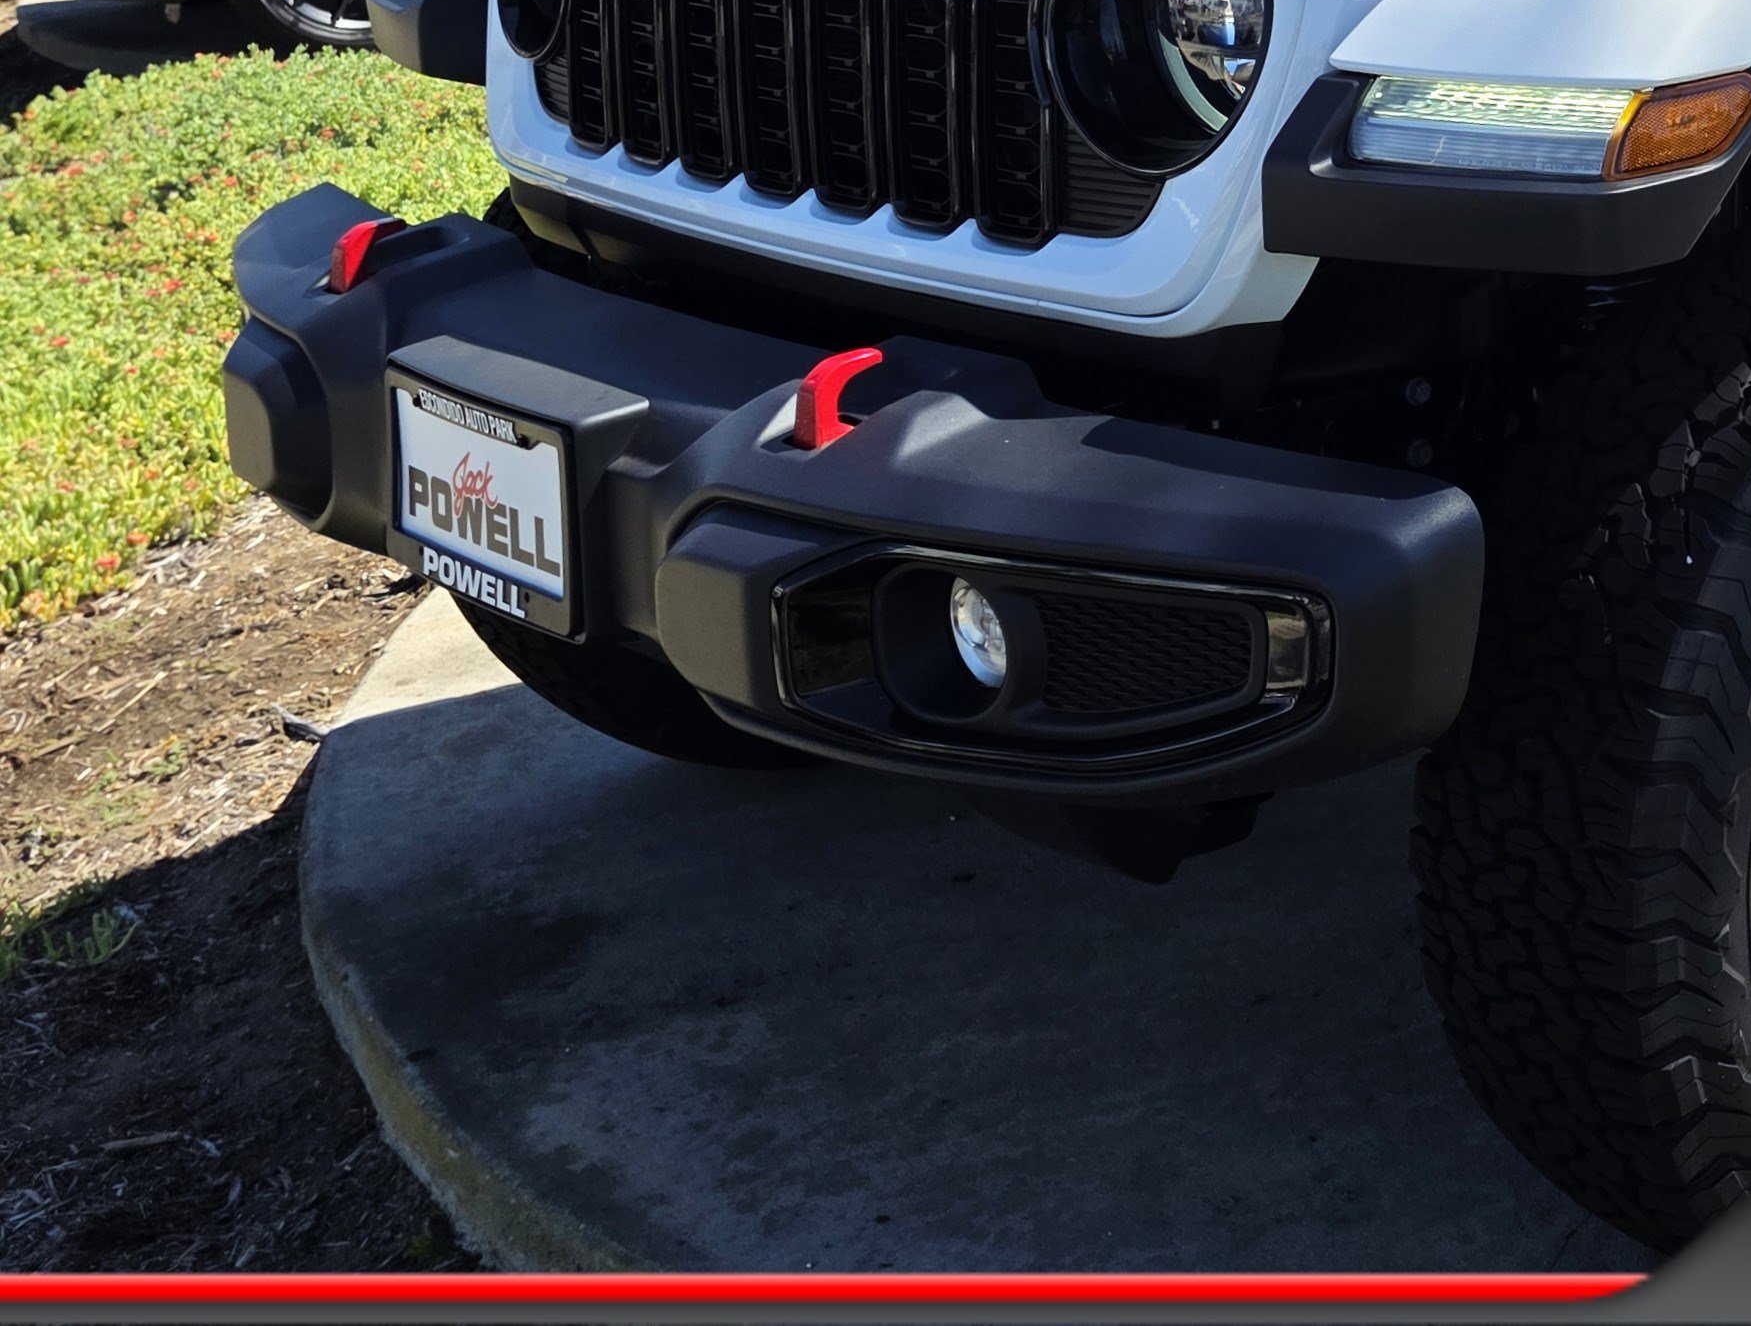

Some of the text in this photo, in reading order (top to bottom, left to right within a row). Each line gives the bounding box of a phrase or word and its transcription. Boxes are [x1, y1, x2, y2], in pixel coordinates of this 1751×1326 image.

[464, 406, 490, 434] AUTO
[487, 415, 518, 444] PARK
[453, 451, 499, 518] Jack
[408, 465, 561, 578] POWELL
[423, 546, 526, 620] POWELL
